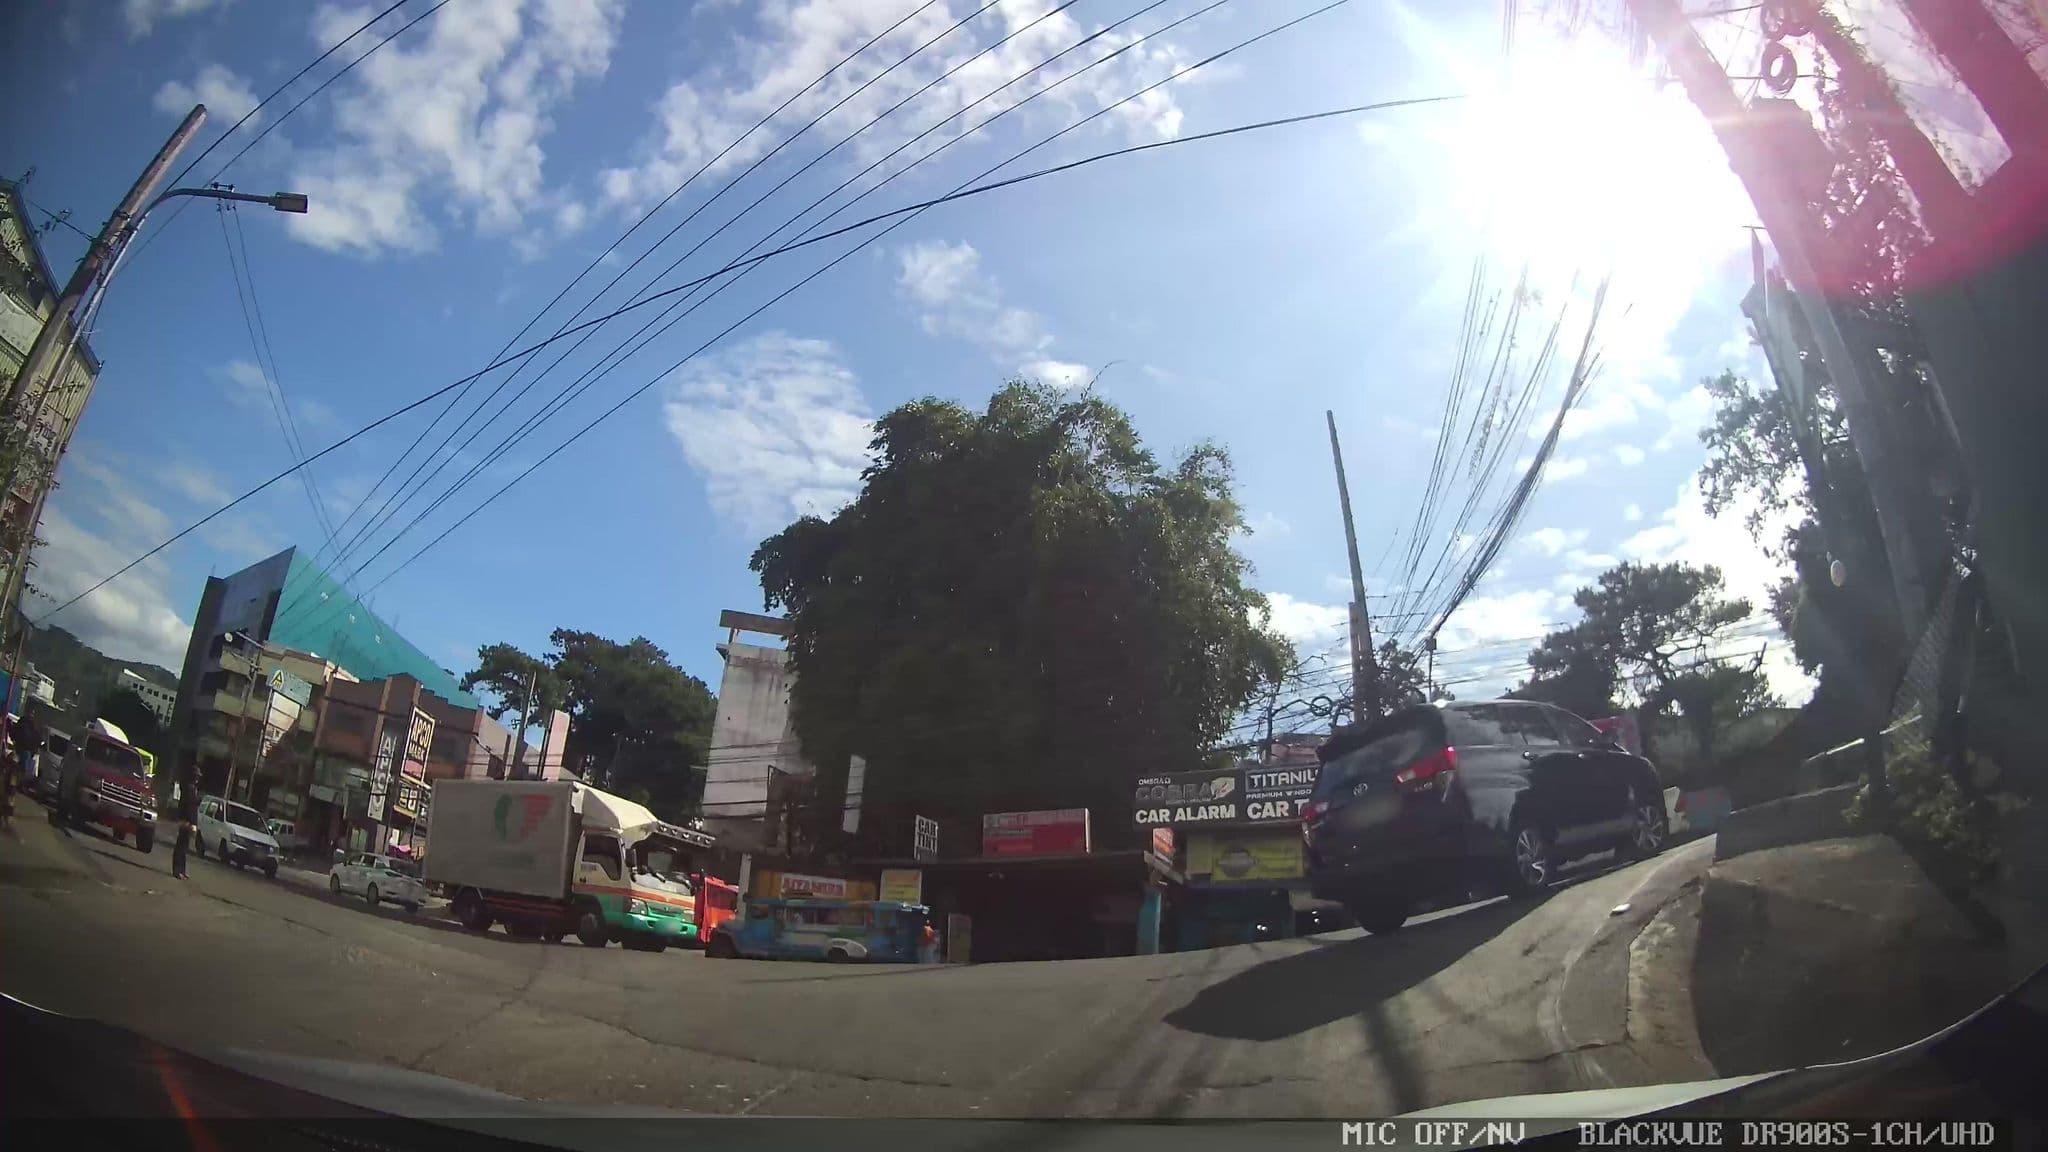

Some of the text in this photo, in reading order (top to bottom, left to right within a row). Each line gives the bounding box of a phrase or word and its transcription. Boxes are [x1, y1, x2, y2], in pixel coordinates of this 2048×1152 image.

[1250, 769, 1318, 788] TITANIU
[1246, 788, 1312, 800] PREMIUM WINDO
[1136, 804, 1236, 823] CAR ALARM
[1247, 801, 1289, 819] CAR
